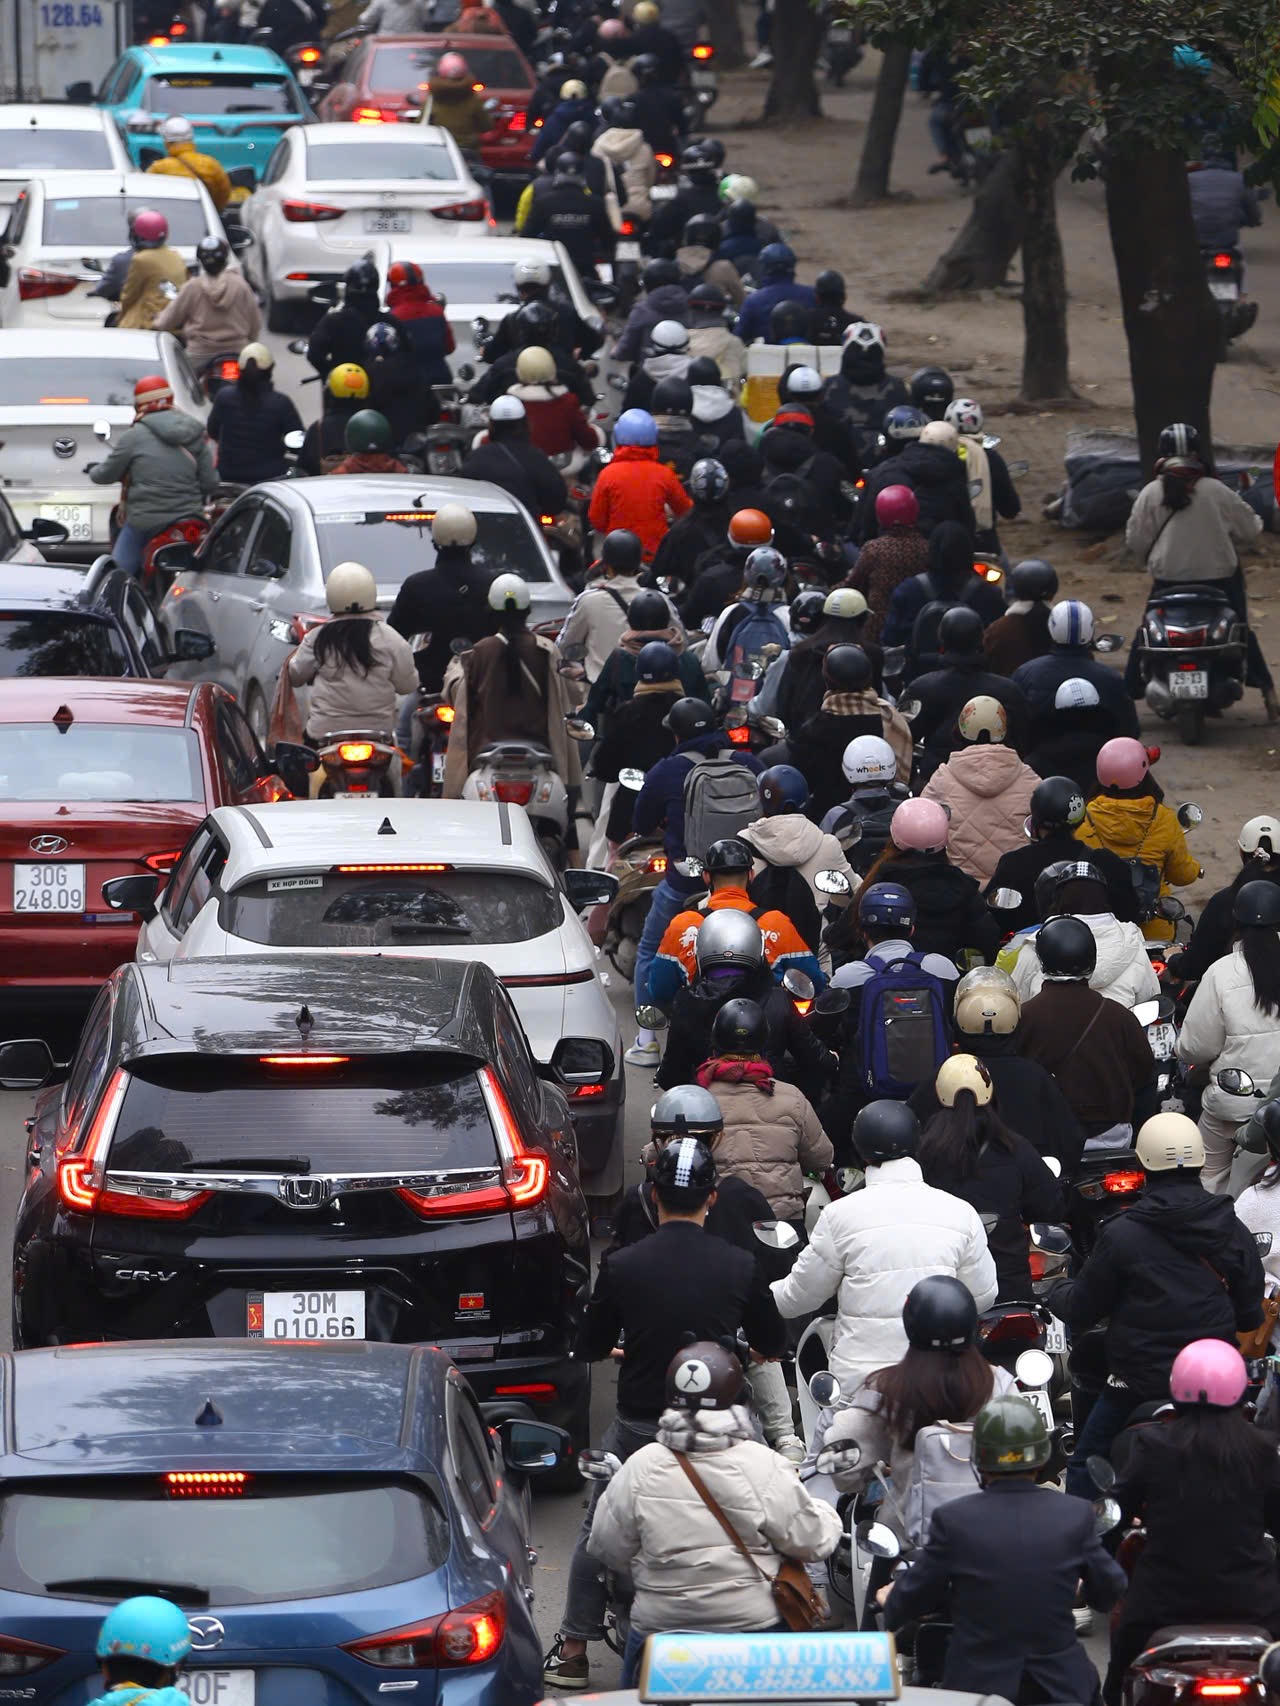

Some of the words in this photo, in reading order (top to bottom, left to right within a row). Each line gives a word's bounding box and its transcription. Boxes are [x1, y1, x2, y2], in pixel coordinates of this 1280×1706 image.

[31, 866, 67, 887] 30G
[16, 889, 82, 910] 248.09
[115, 1269, 178, 1281] CR-V
[292, 1293, 337, 1315] 30M
[273, 1316, 356, 1339] 010.66
